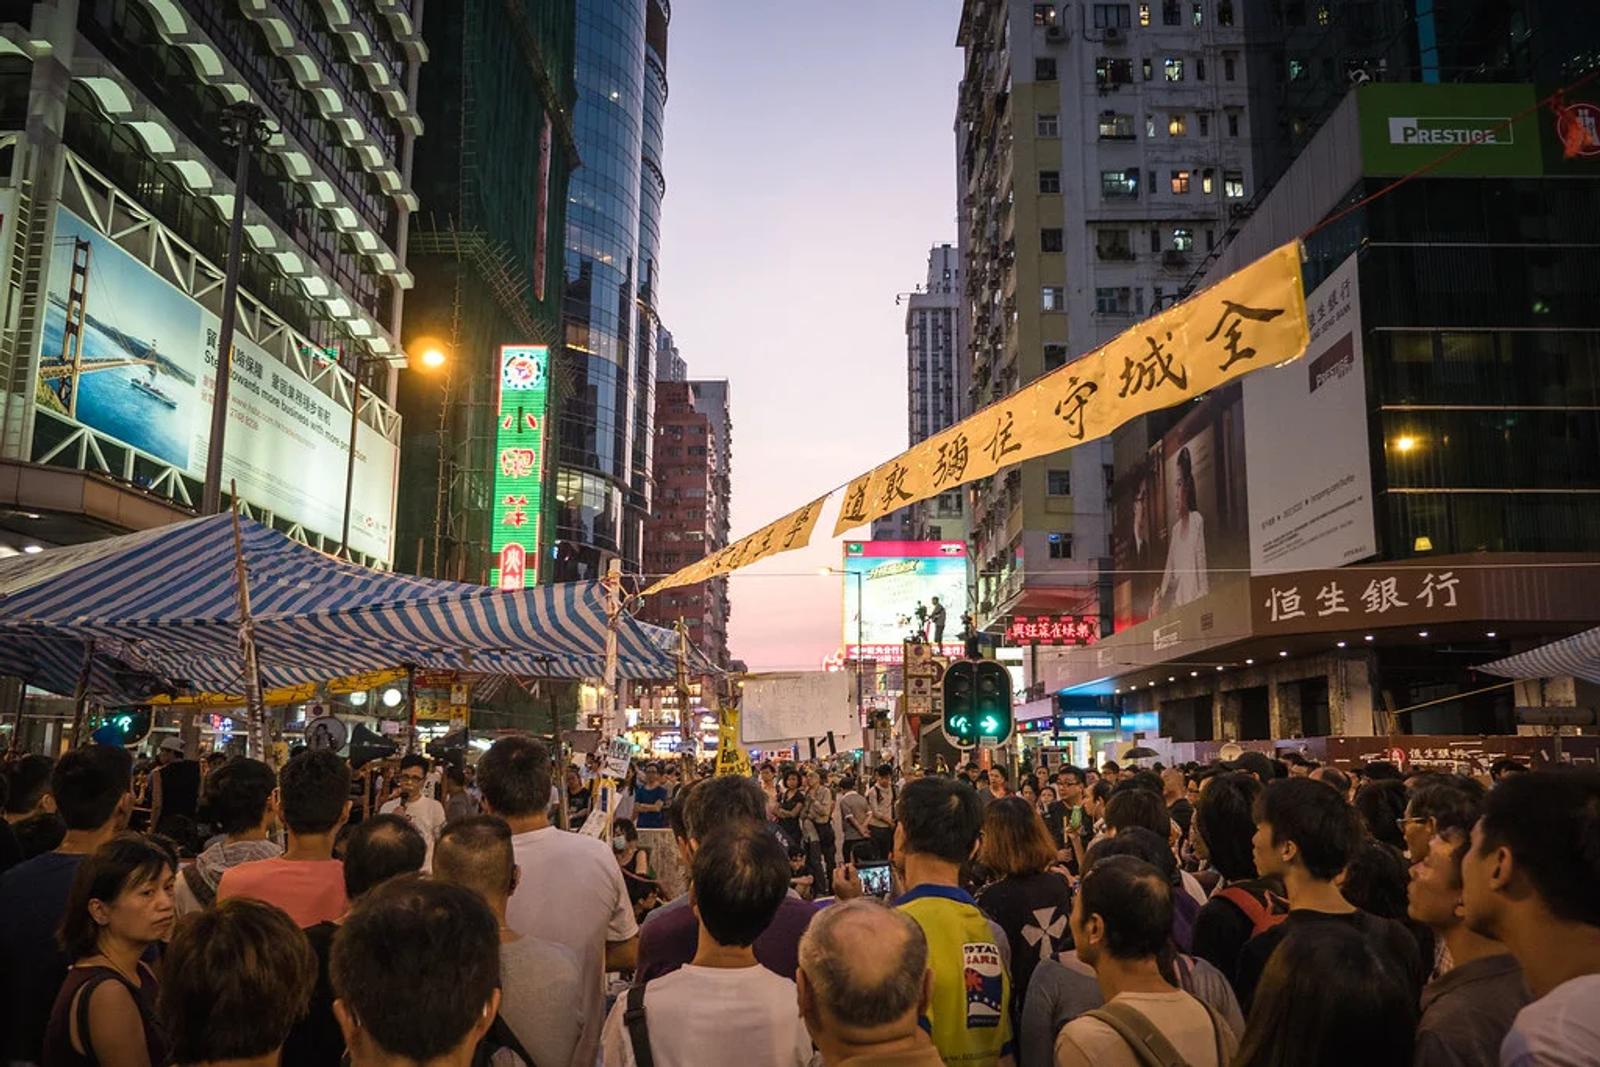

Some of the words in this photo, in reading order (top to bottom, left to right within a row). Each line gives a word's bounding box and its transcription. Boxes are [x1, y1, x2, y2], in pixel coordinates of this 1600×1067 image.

[1402, 126, 1498, 143] PRESTIGE
[1265, 571, 1460, 622] 恒生銀行
